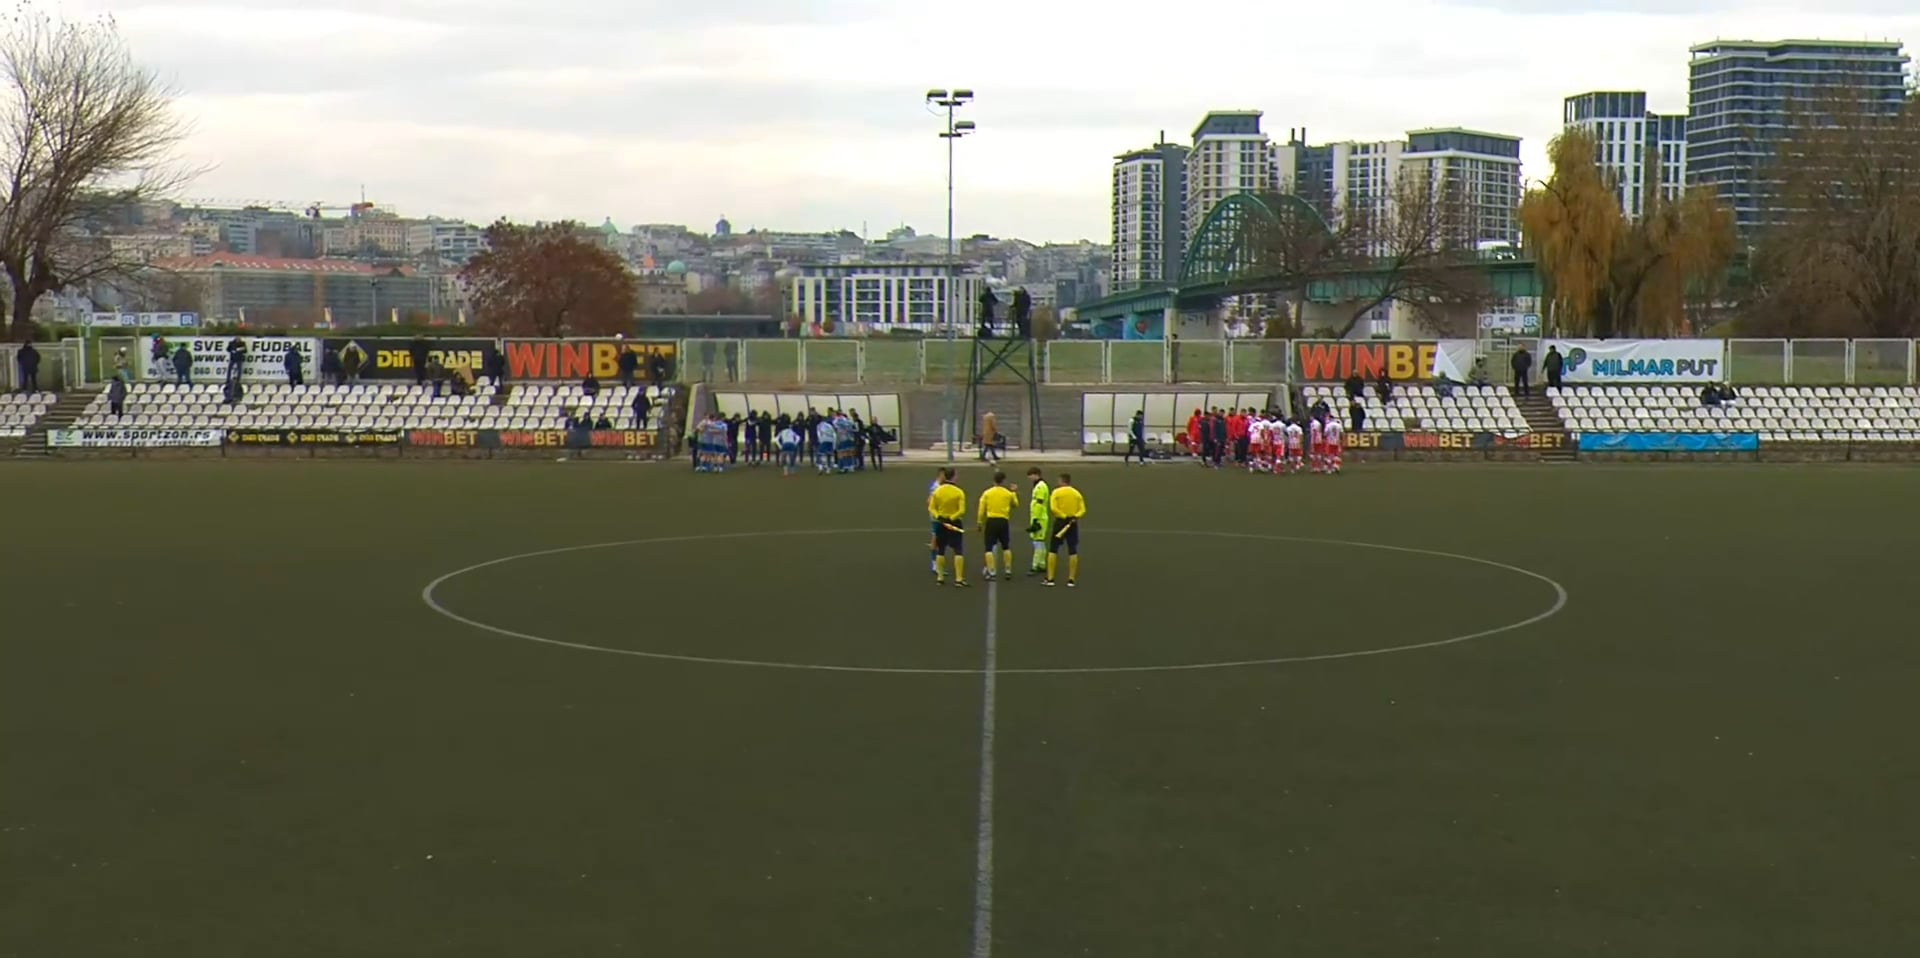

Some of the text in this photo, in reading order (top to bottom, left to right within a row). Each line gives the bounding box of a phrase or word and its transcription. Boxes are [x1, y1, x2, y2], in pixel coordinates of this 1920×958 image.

[193, 340, 224, 352] SVE
[252, 340, 312, 353] FUDBAL
[425, 350, 483, 369] RADE
[1299, 343, 1439, 380] WINBE
[1592, 358, 1718, 377] MILMAR PUT
[82, 429, 211, 442] www.sportzon.rs
[1342, 432, 1382, 448] BET
